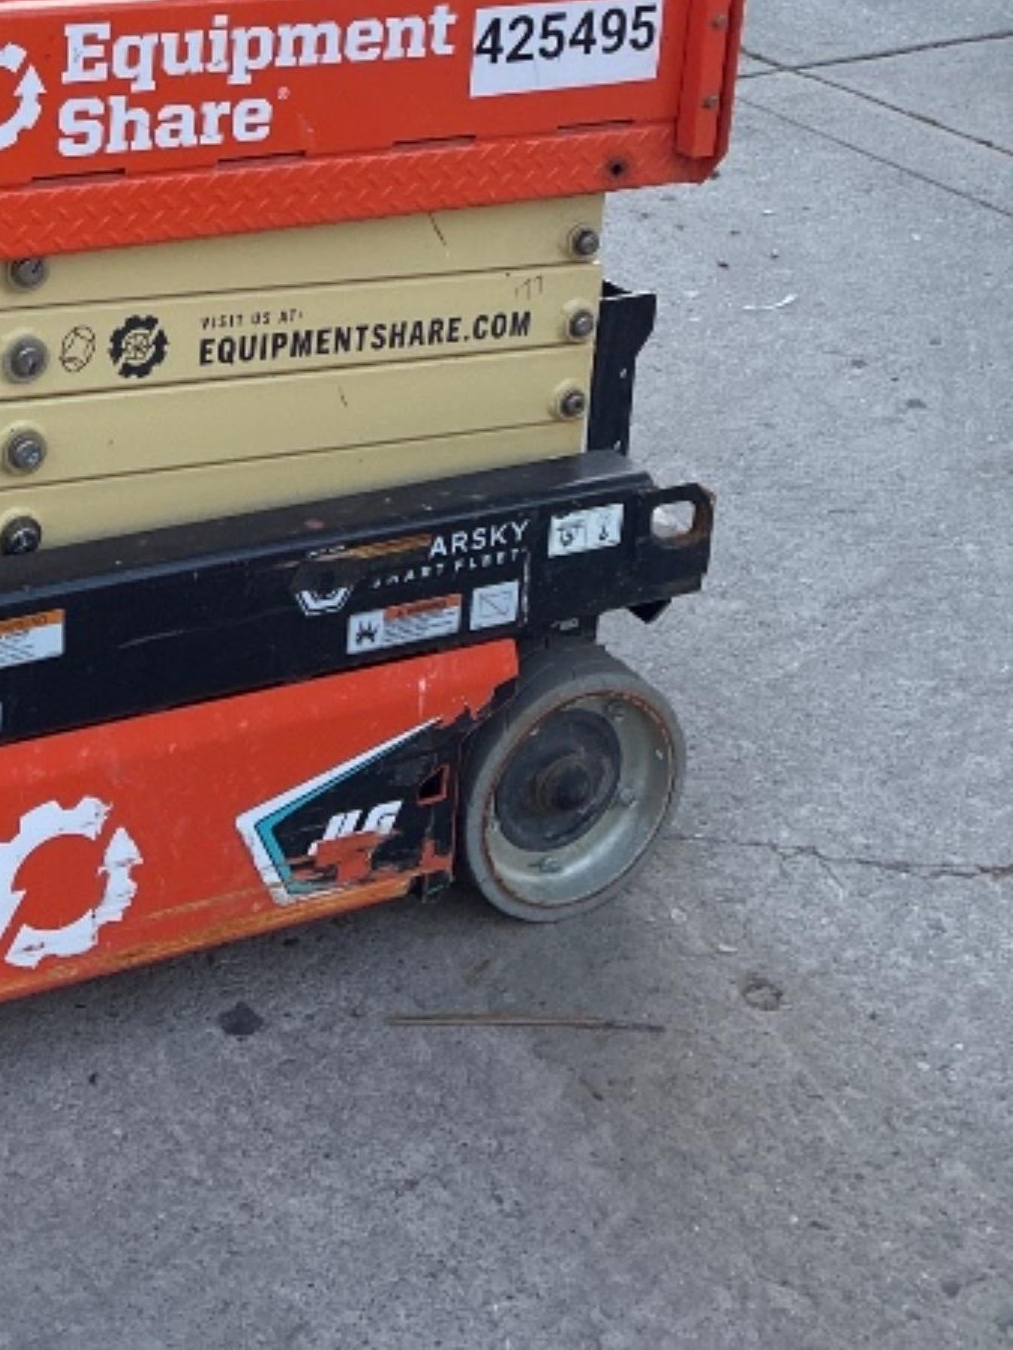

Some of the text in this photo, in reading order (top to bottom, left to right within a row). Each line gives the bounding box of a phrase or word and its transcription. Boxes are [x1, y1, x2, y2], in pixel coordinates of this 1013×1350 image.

[61, 4, 458, 93] Equipment
[474, 4, 658, 64] 425495
[199, 310, 532, 367] EQUIPMENTSHARE.COM
